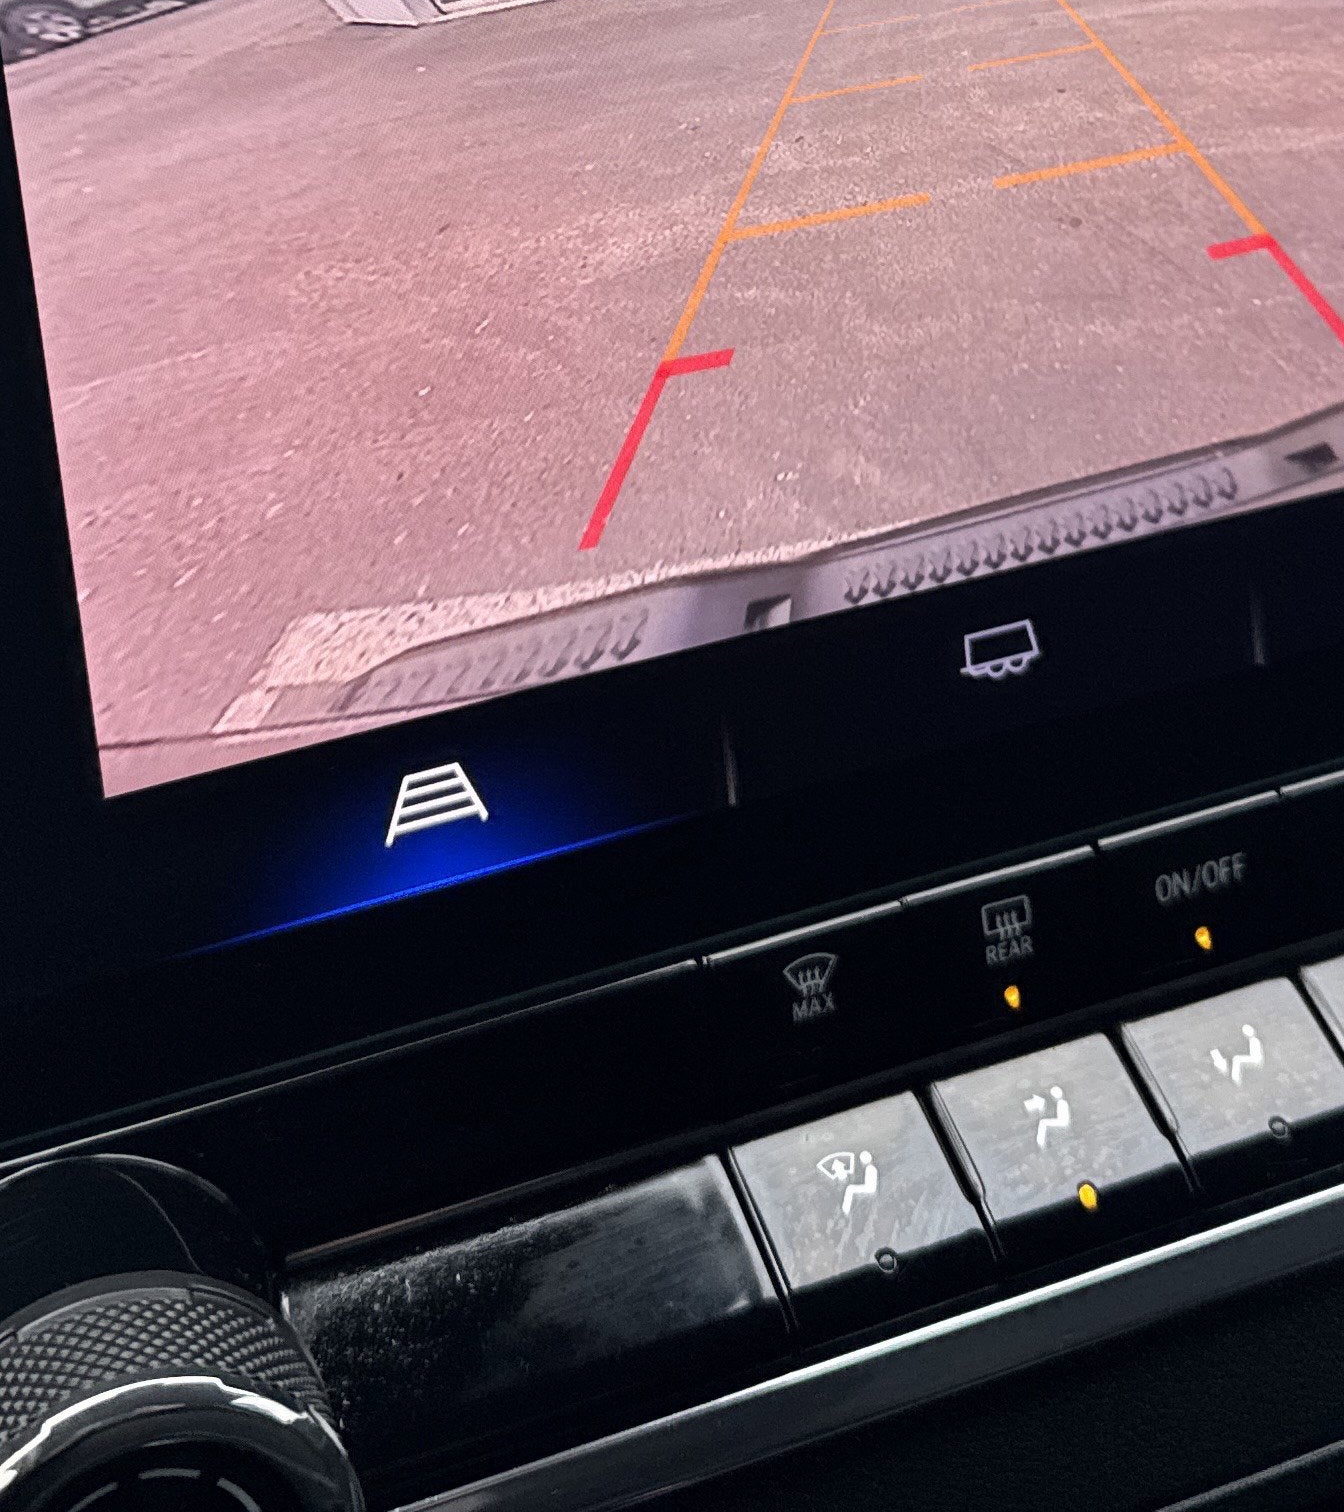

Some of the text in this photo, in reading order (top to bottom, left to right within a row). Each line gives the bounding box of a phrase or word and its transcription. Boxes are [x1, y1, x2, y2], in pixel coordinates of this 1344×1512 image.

[1155, 852, 1246, 903] ON/OFF
[984, 936, 1033, 966] REAR
[792, 992, 837, 1022] MAX
